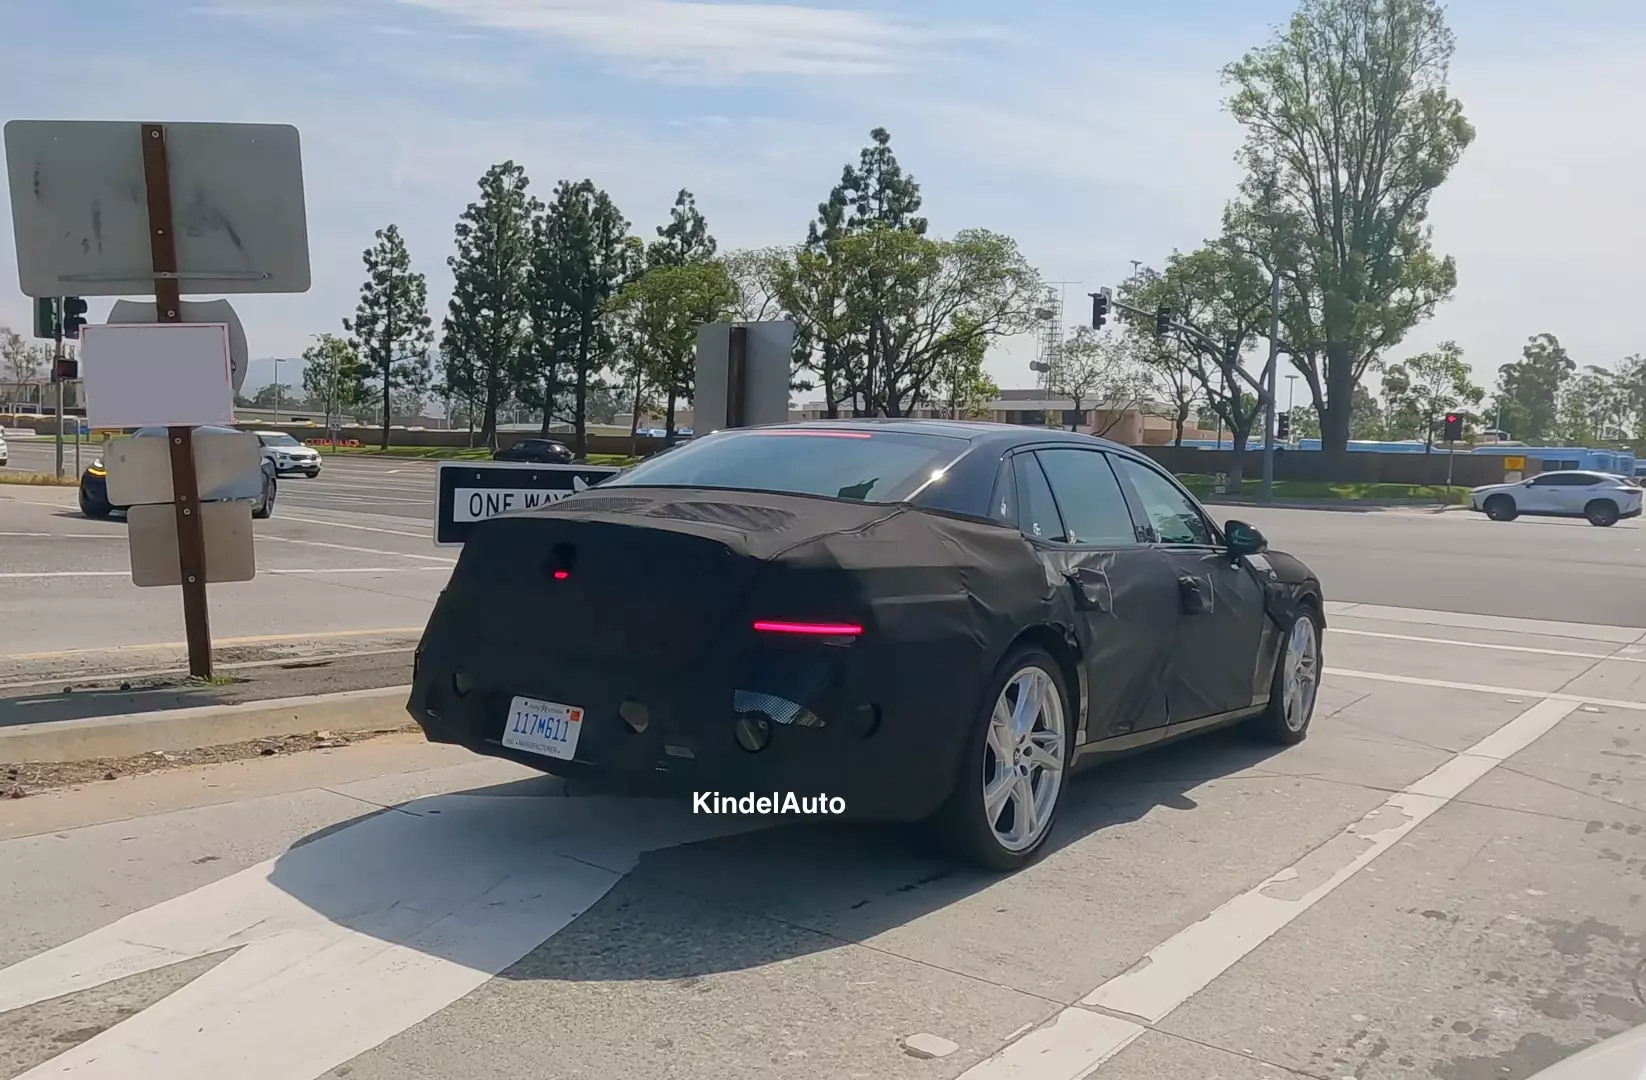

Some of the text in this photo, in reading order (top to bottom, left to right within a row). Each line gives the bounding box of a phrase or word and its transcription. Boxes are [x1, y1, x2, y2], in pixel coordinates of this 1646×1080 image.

[469, 492, 568, 518] ONE WA
[512, 711, 570, 743] 117M611
